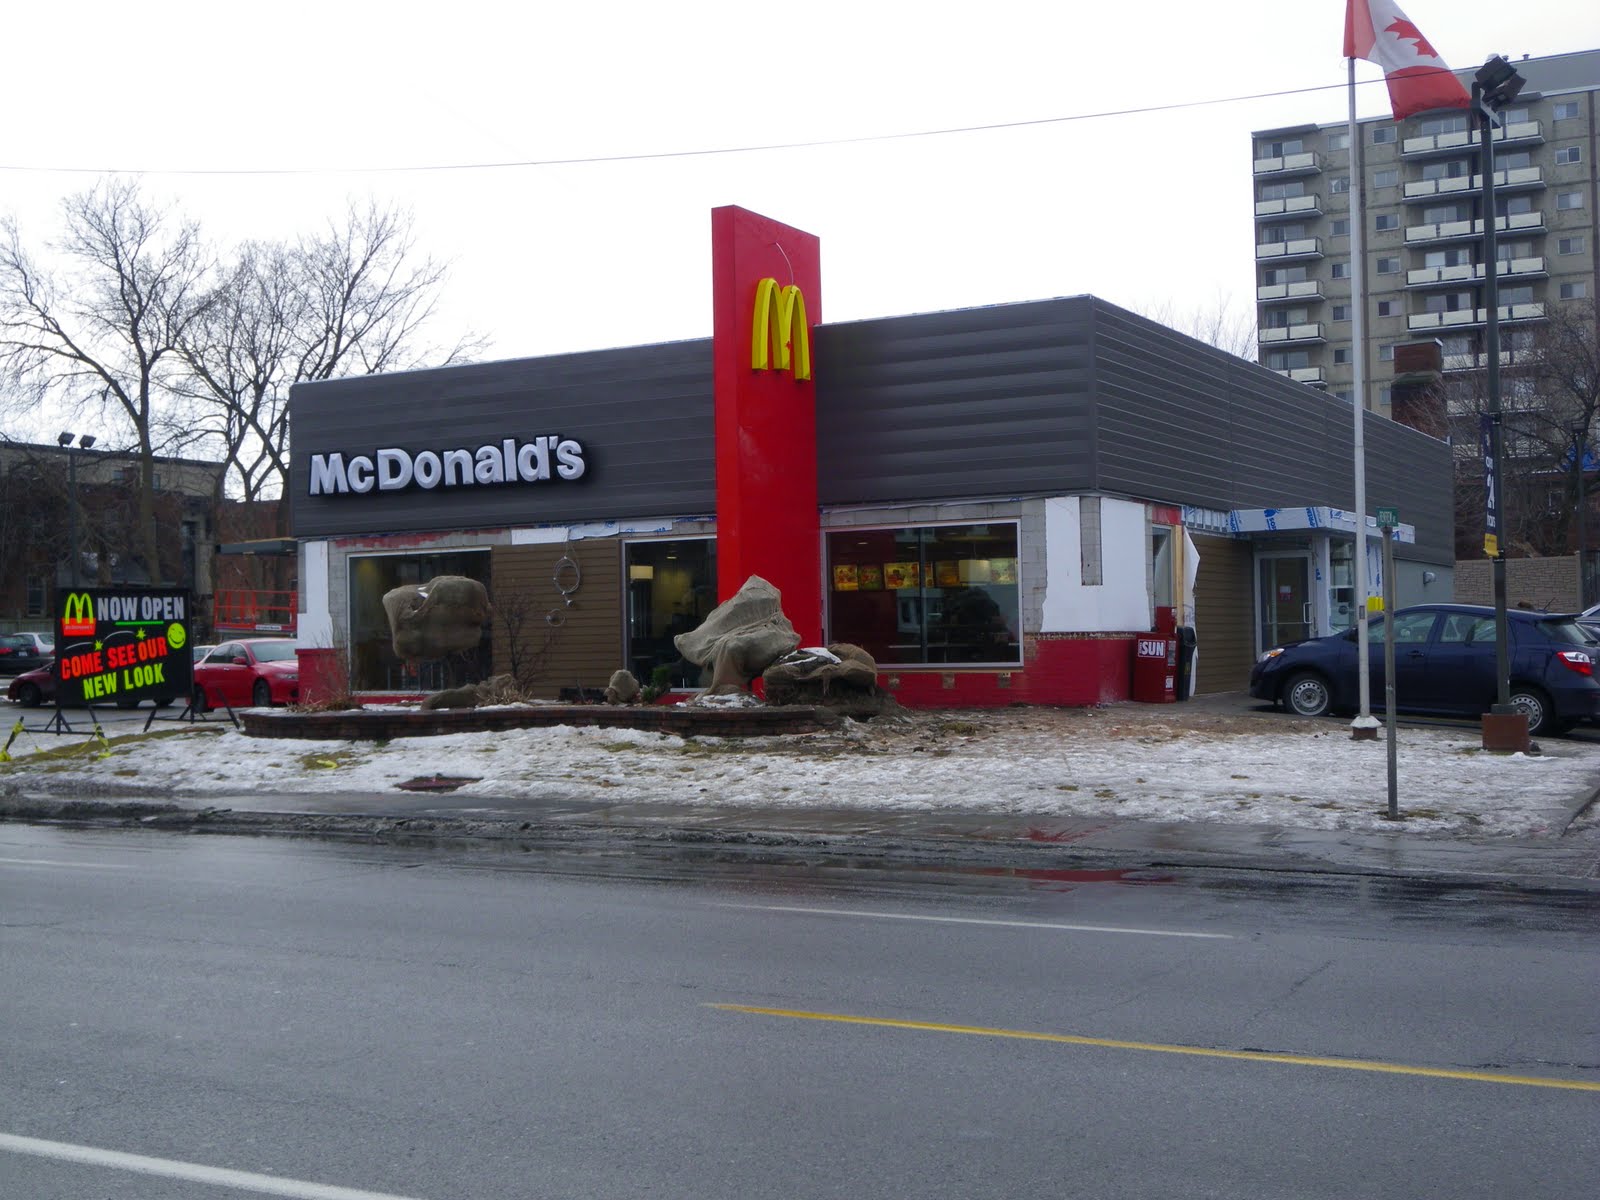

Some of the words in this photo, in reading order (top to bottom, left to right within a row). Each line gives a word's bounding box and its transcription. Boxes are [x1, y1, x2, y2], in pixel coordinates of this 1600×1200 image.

[309, 435, 585, 495] McDonald's
[97, 597, 138, 621] NOW
[141, 596, 185, 620] OPEN
[61, 651, 104, 680] COME
[107, 643, 137, 669] SEE
[138, 636, 168, 661] OUR
[1142, 641, 1164, 656] SUN
[83, 672, 117, 699] NEW
[124, 662, 165, 690] LOOK
